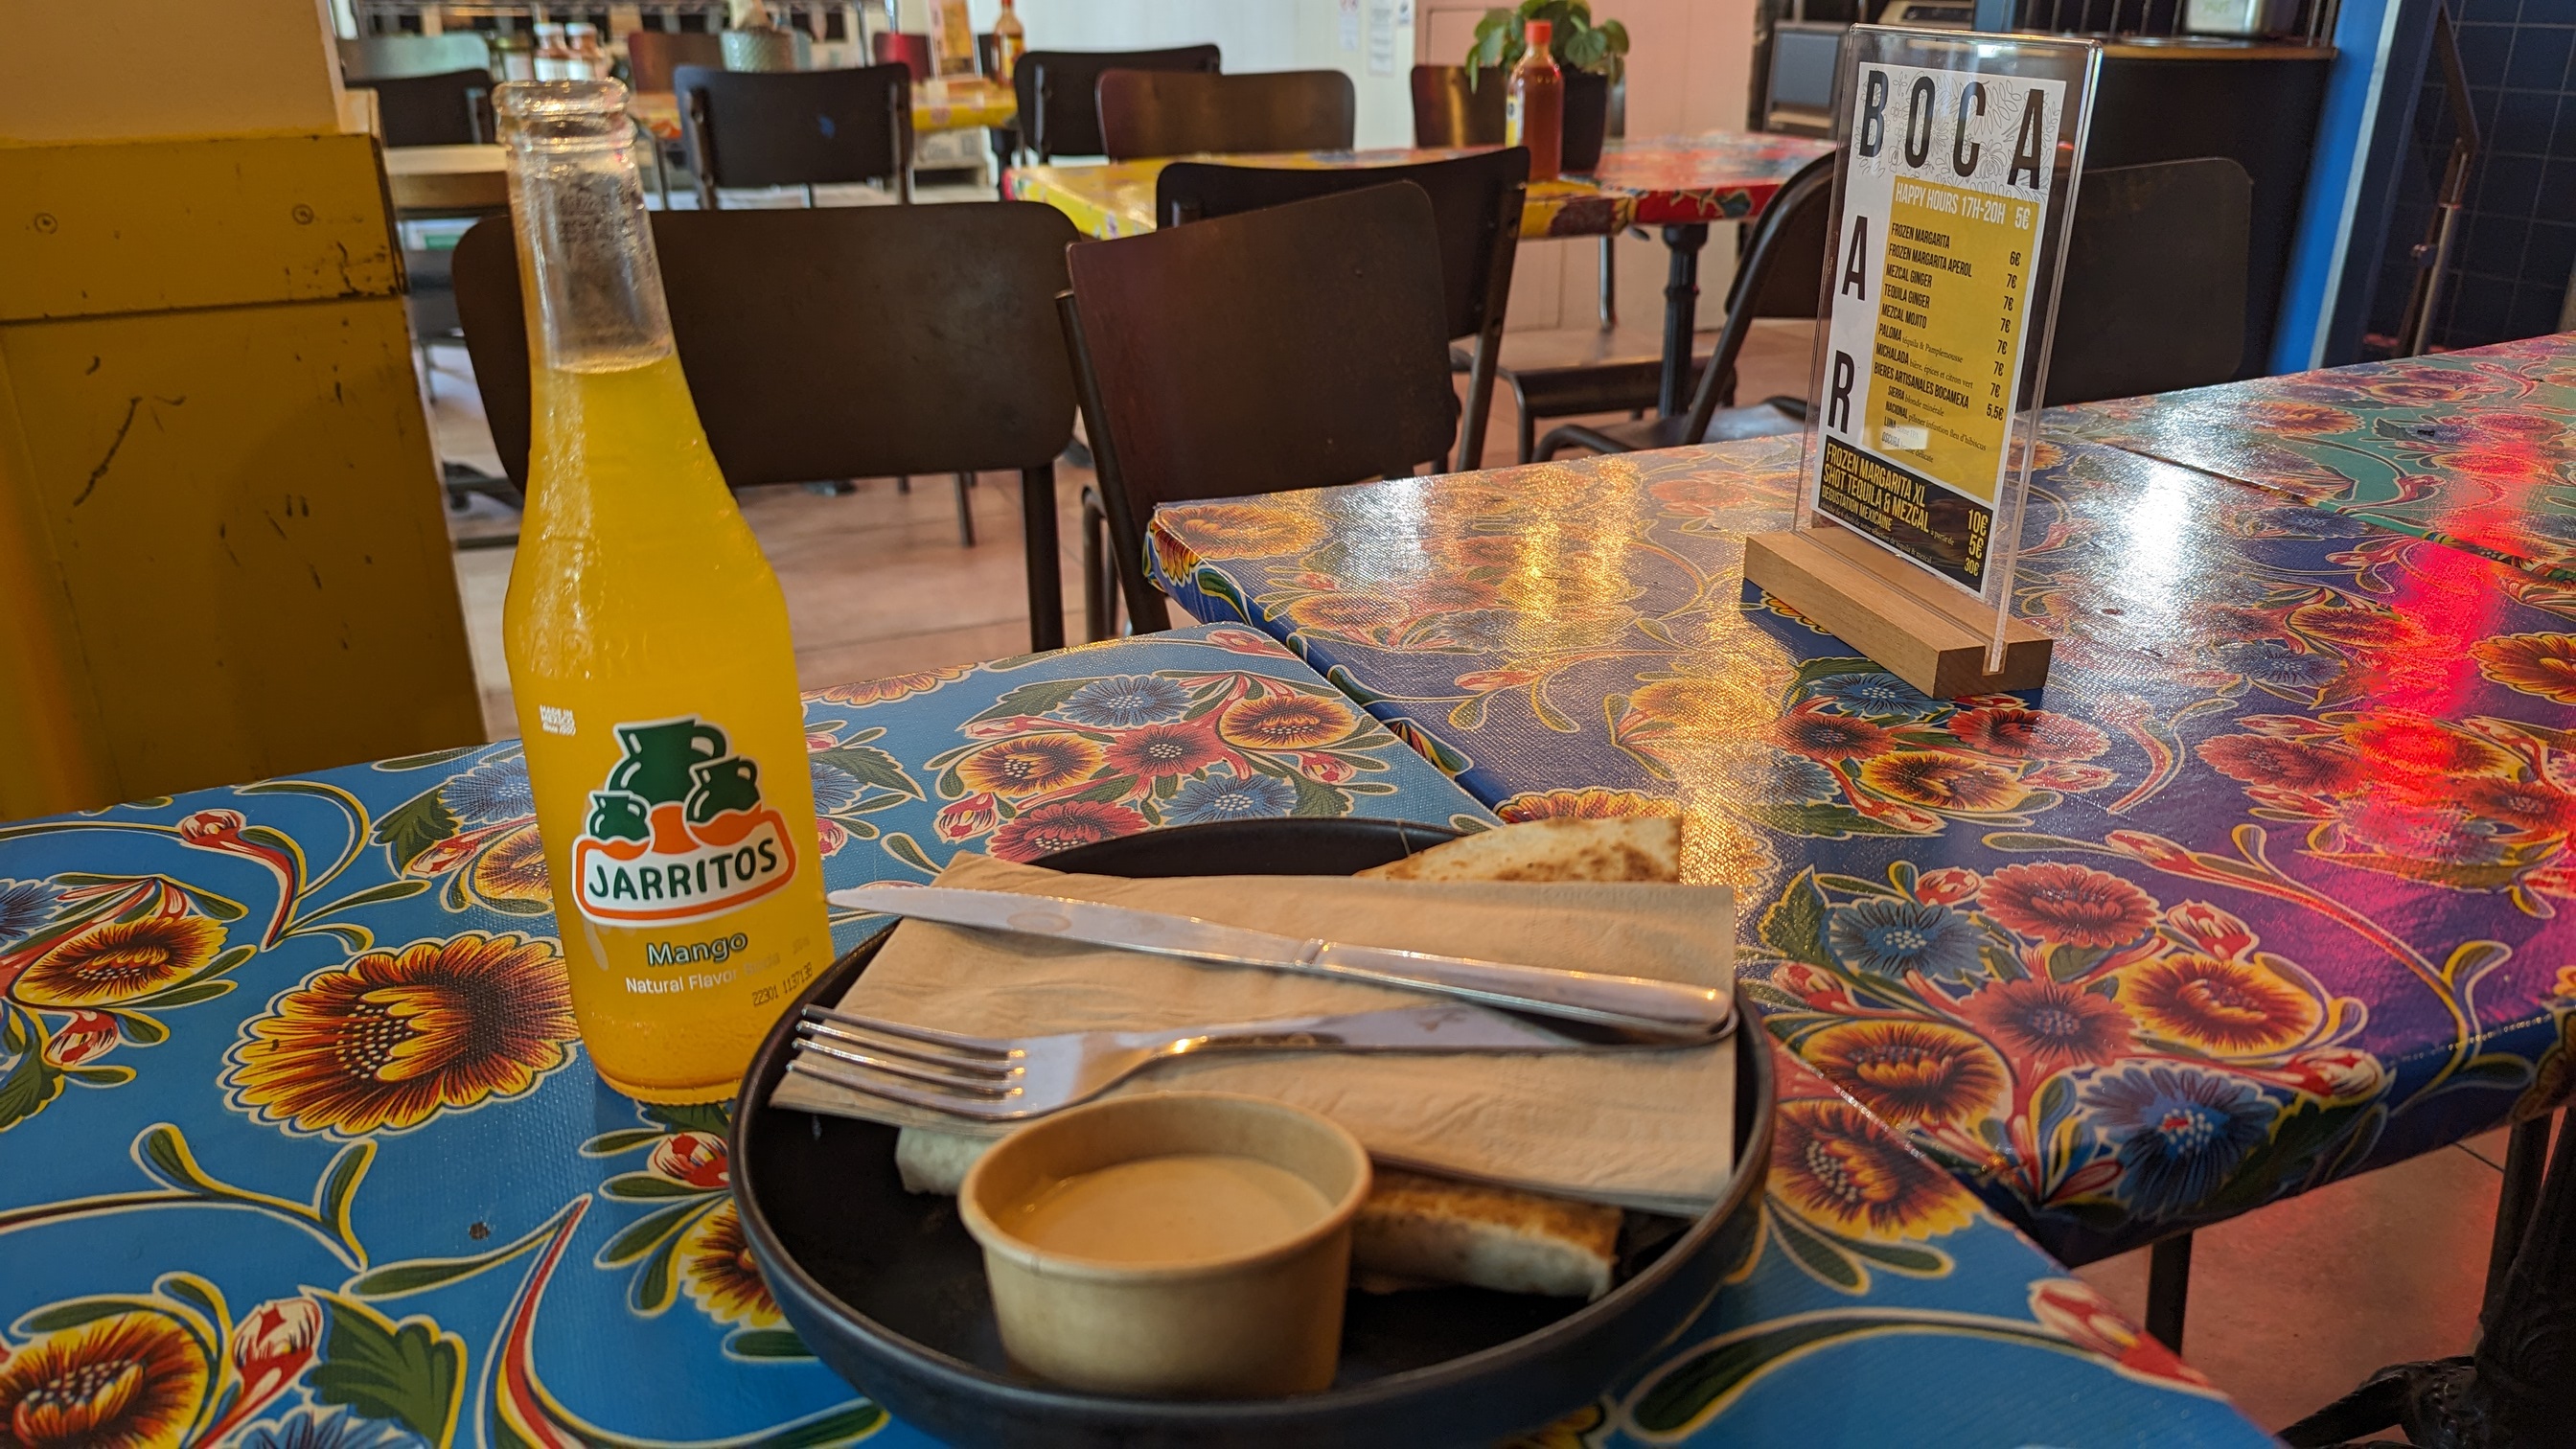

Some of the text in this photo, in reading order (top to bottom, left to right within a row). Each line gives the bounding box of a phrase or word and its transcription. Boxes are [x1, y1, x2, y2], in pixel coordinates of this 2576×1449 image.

[1858, 69, 2045, 190] BOCA
[1895, 182, 2031, 230] HAPPY HOURS 17H-20H 5€
[1888, 243, 2018, 289] FROZEN MARGARITA APEROL 7€
[1891, 222, 2021, 266] FROZEN MARGARITA 6€
[1884, 284, 2011, 334] TEQUILA GINGER 7€
[1885, 264, 2014, 311] MEZCAL GINGER 7€
[1878, 323, 1902, 342] PALOMA
[1925, 344, 1964, 363] Pamplemousse
[1993, 360, 2005, 377] 7€
[1881, 303, 2008, 356] MEZCAL MOJITO 7€
[1874, 361, 2005, 421] BIERES ARTISANALES BOCAMEXA 5,5€
[1875, 342, 1909, 365] MICHALADA
[1945, 372, 1962, 385] citron
[1962, 379, 1974, 389] vert
[1990, 382, 2001, 399] 7€
[1885, 401, 1908, 419] NACIONAL
[1887, 385, 1944, 417] SIERRA blonde minérale
[1823, 464, 1847, 491] SHOT
[1847, 473, 1882, 509] TEQUILA
[1883, 493, 1891, 513] &
[1892, 496, 1930, 533] MEZCAL
[1967, 533, 1983, 559] 5€
[1826, 443, 1989, 537] FROZEN MARGARITA XL 10€
[1821, 485, 1979, 577] DEGUSTATION MEXICAINE 30€
[587, 837, 778, 902] JARRITOS
[646, 932, 748, 968] Mango
[625, 977, 684, 994] Natural
[688, 968, 738, 991] Flavor
[751, 984, 779, 1008] 22301
